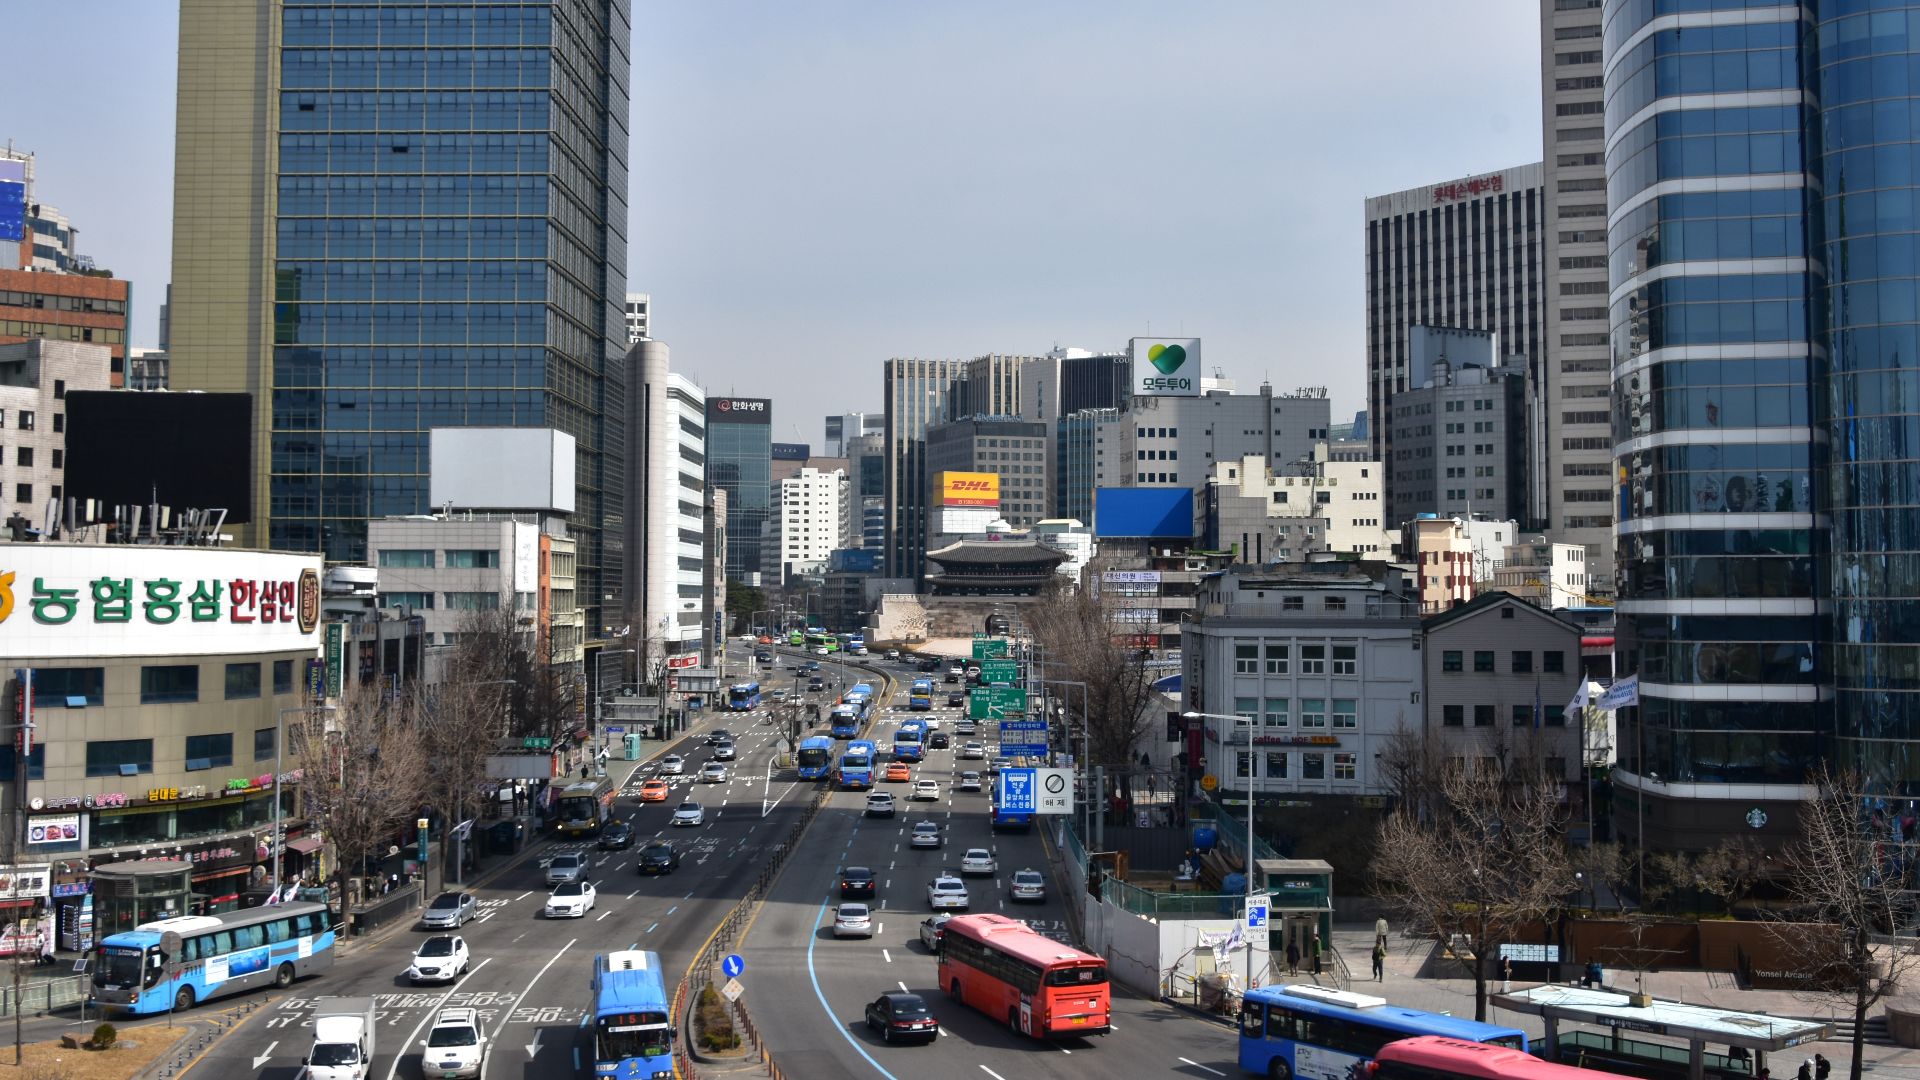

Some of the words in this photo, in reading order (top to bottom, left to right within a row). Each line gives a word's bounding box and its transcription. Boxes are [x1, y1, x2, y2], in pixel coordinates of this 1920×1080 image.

[1433, 174, 1503, 203] 롯데손해보험
[1143, 378, 1190, 390] 모두투어
[732, 401, 764, 412] 한화생명
[952, 480, 992, 491] DHL
[29, 576, 224, 624] 농협홍삼
[229, 578, 296, 624] 한삼인
[1252, 736, 1281, 744] coffee
[148, 786, 178, 802] 남대문
[184, 964, 202, 977] 7111
[1079, 972, 1092, 980] 9401
[1756, 970, 1782, 978] Yonsei
[1784, 970, 1813, 978] Arcade
[620, 1014, 648, 1024] 151
[1021, 1010, 1030, 1032] R
